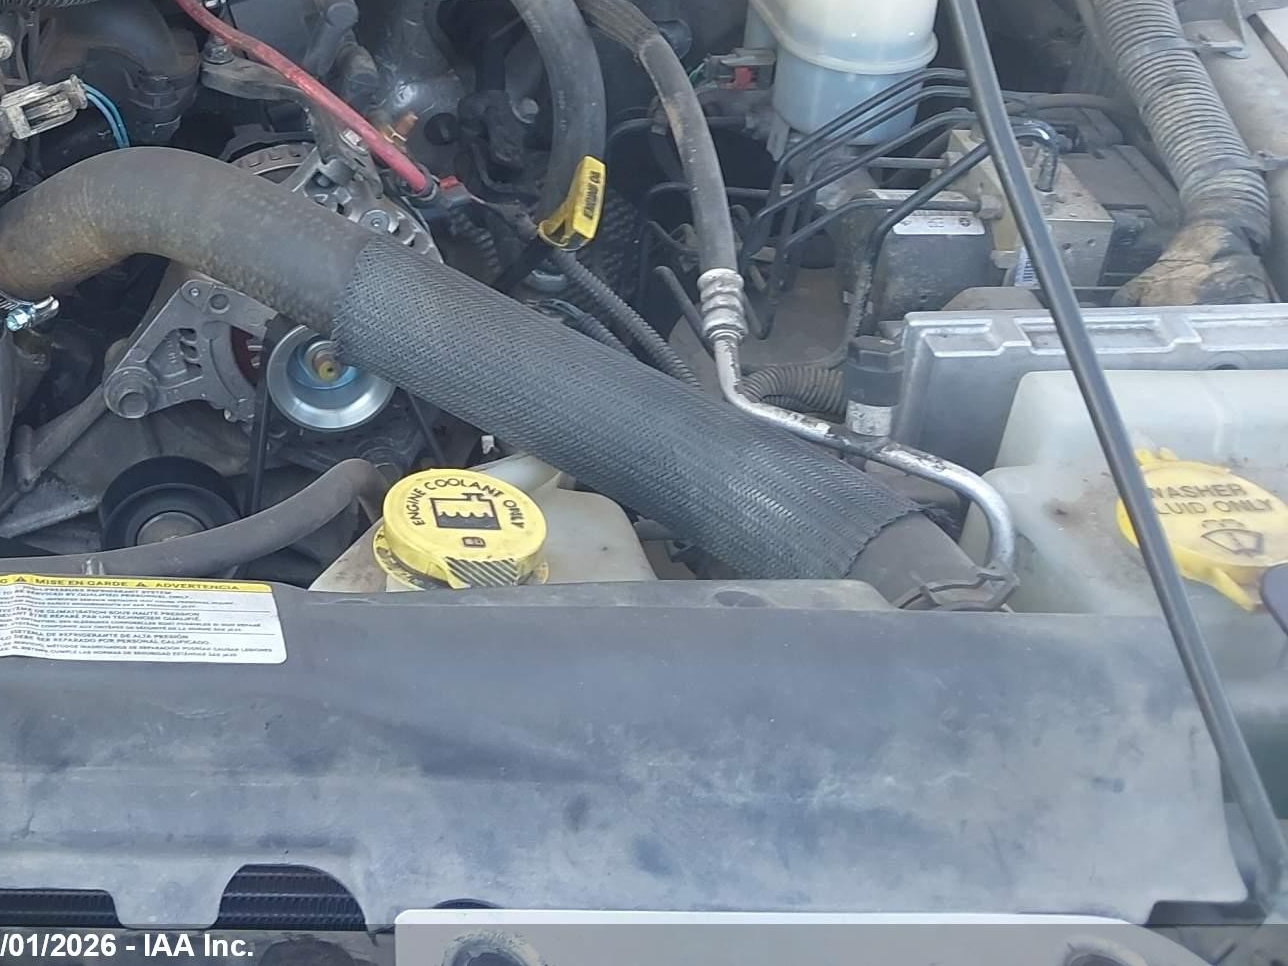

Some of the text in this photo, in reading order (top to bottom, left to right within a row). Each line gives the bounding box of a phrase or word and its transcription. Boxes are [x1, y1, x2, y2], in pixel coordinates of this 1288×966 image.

[405, 478, 526, 529] ENGINE COOLANT ONLY
[1154, 498, 1274, 515] LUID ONLY
